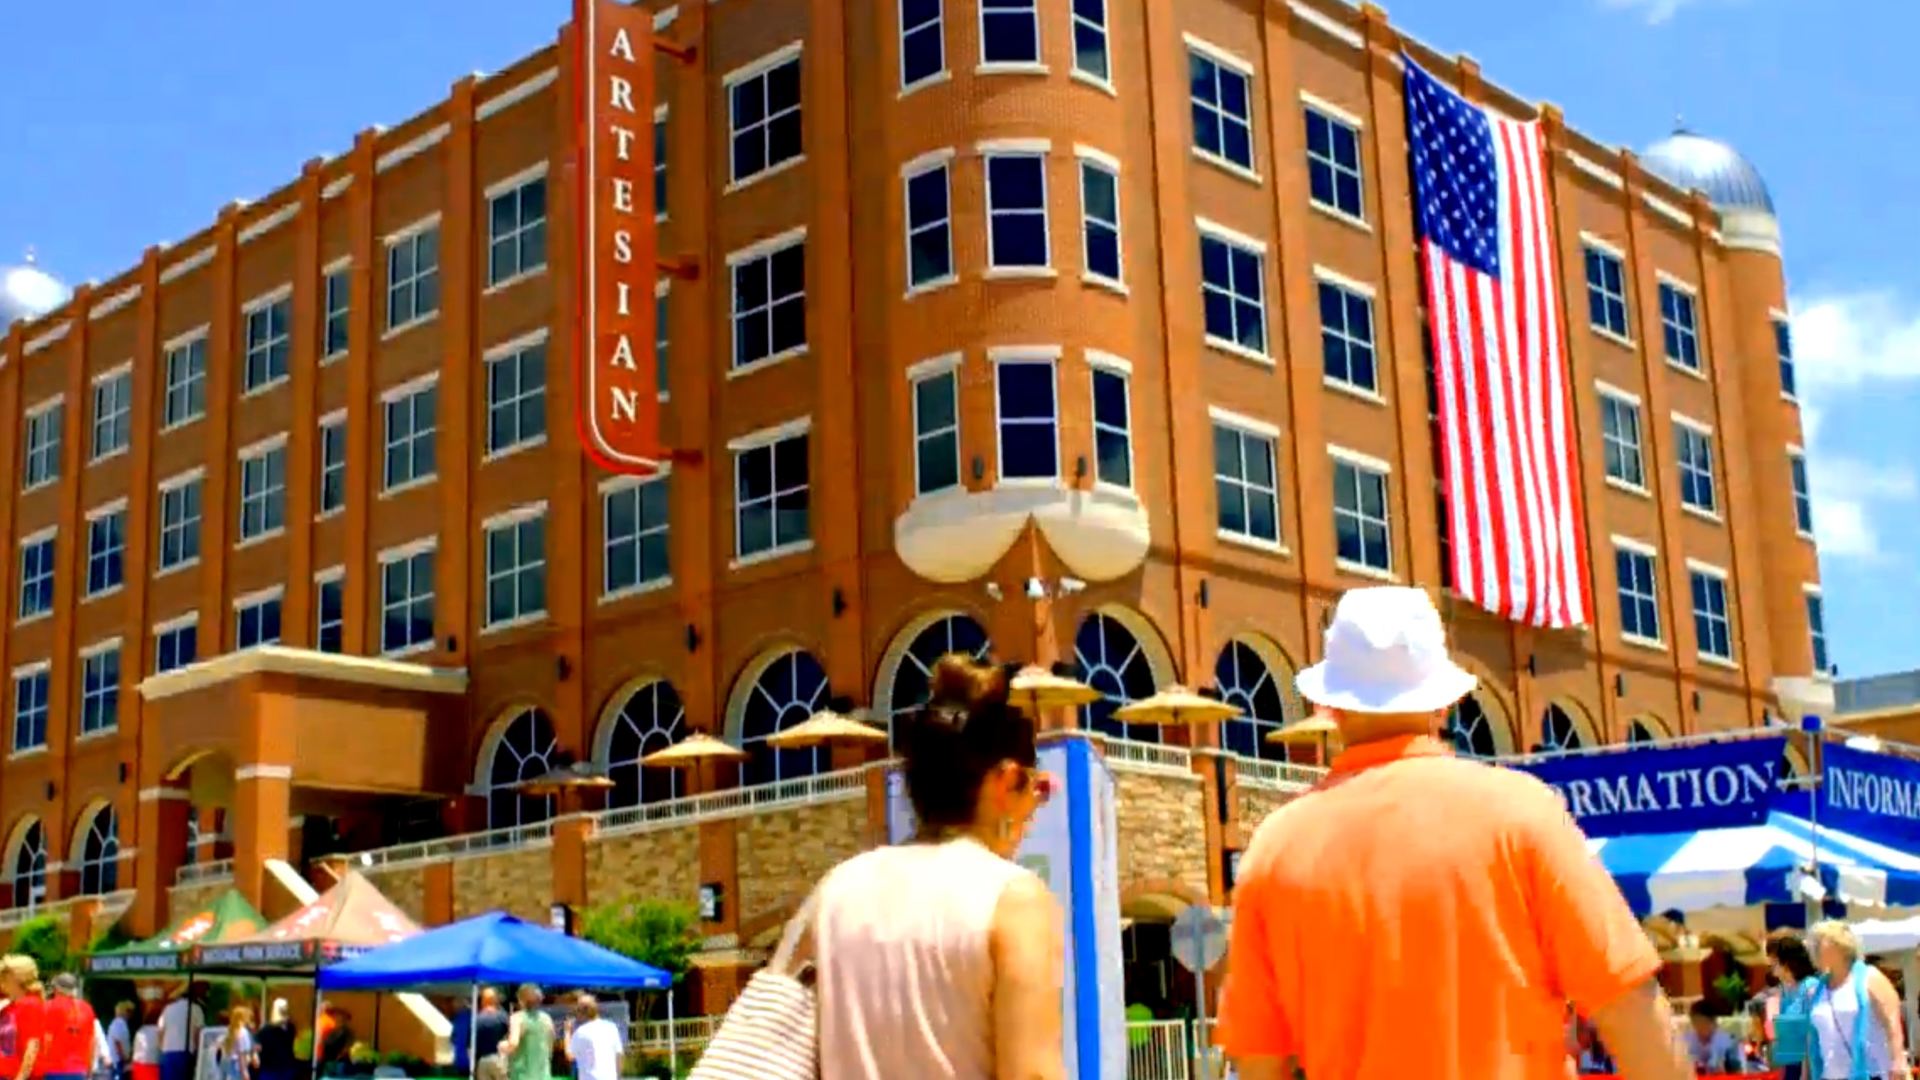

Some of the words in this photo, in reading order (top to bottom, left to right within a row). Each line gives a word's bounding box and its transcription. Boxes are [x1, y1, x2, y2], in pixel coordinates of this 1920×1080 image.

[609, 28, 639, 422] ARTESIAN
[1553, 762, 1777, 817] RMATION
[243, 944, 263, 960] PARK
[265, 942, 301, 960] SERVICE
